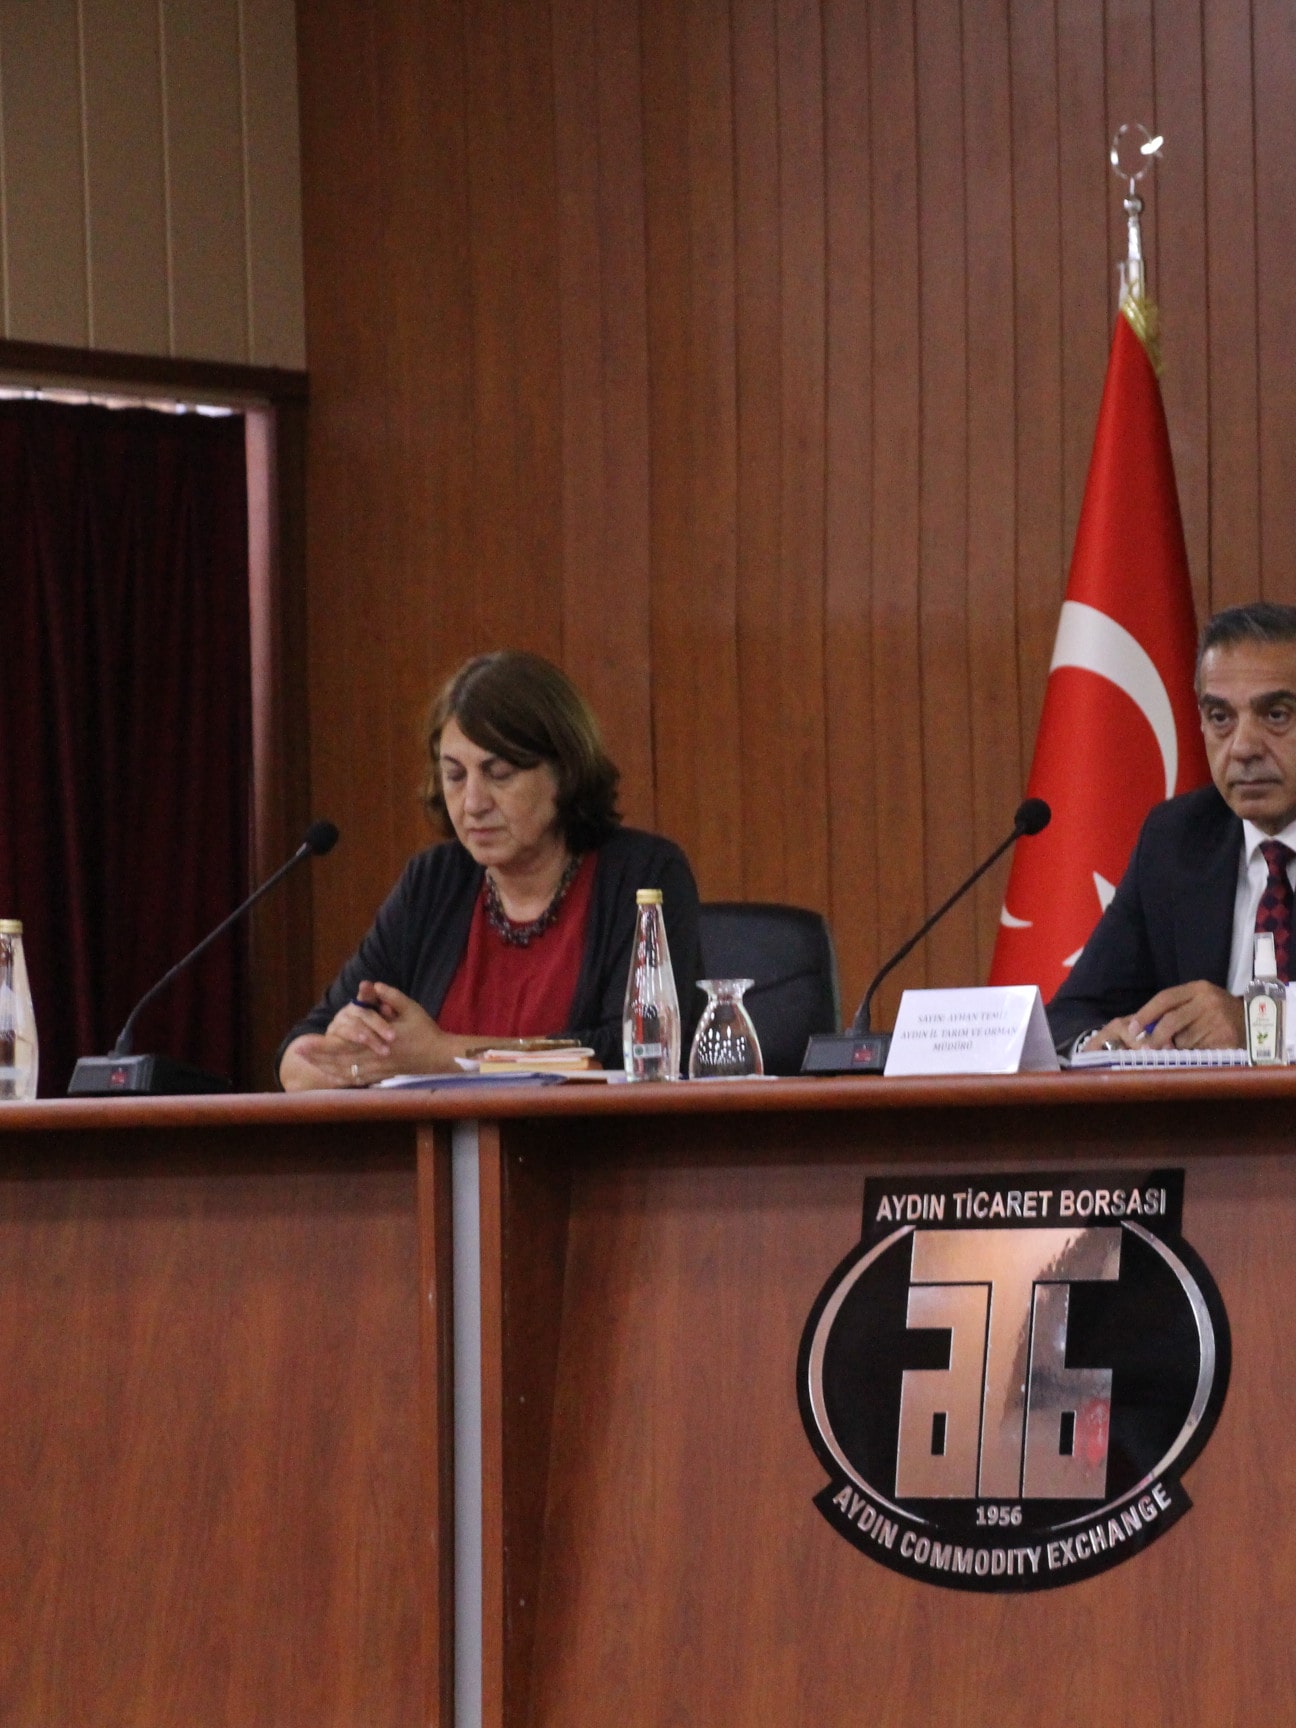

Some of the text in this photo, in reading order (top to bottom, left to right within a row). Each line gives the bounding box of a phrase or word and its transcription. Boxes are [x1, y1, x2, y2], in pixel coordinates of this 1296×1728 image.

[875, 1187, 1167, 1222] AYDIN TİCARET BORSASI
[832, 1481, 1173, 1576] AYDIN COMMODITY EXCHANGE
[976, 1505, 1023, 1527] 1956
